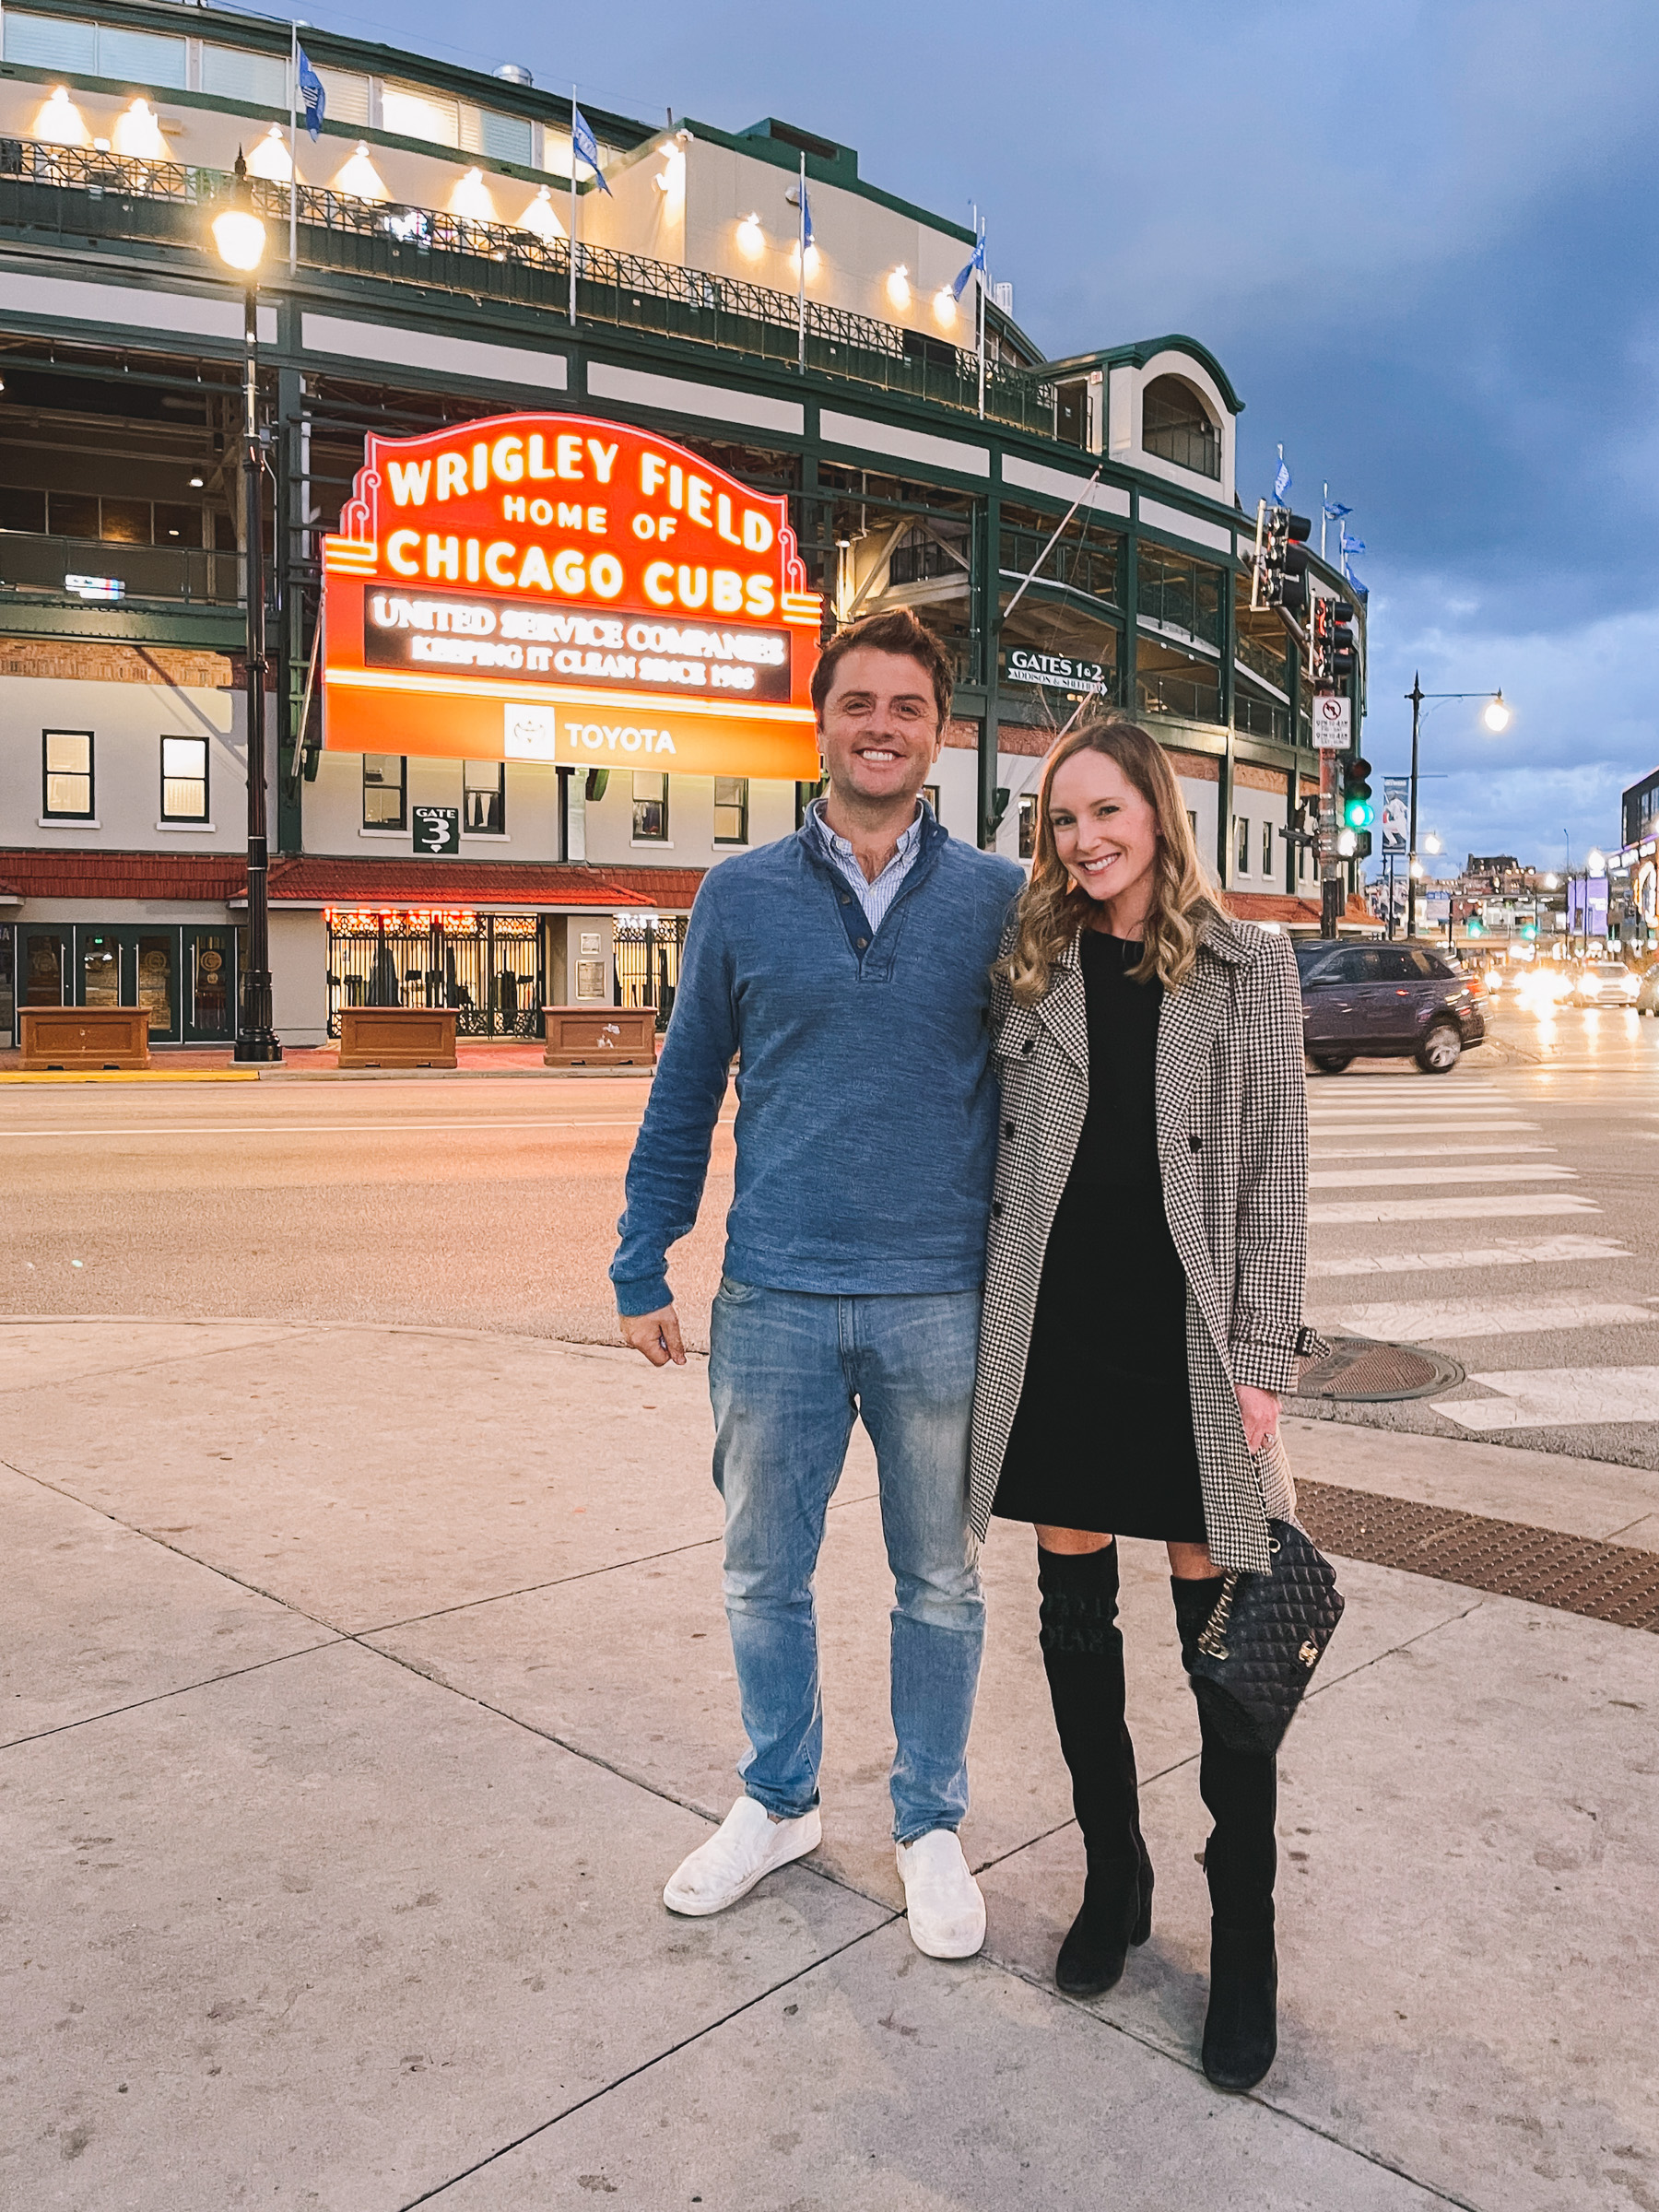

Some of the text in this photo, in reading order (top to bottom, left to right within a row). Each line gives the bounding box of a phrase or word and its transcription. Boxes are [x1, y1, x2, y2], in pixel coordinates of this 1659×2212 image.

[386, 434, 774, 554] WRIGLEY FIELD
[502, 494, 678, 542] HOME OF
[386, 528, 776, 617] CHICAGO CUBS
[372, 595, 785, 665] UNITED SERVICE COMPANIES
[411, 635, 524, 670] KEEPING
[526, 646, 553, 672] IT
[553, 649, 637, 679] CLEAN
[639, 656, 707, 687] SINCE
[1012, 651, 1072, 676] GATES
[1012, 670, 1052, 685] ADDISON
[563, 722, 677, 755] TOYOTA
[416, 808, 455, 818] GATE
[421, 818, 451, 844] 3
